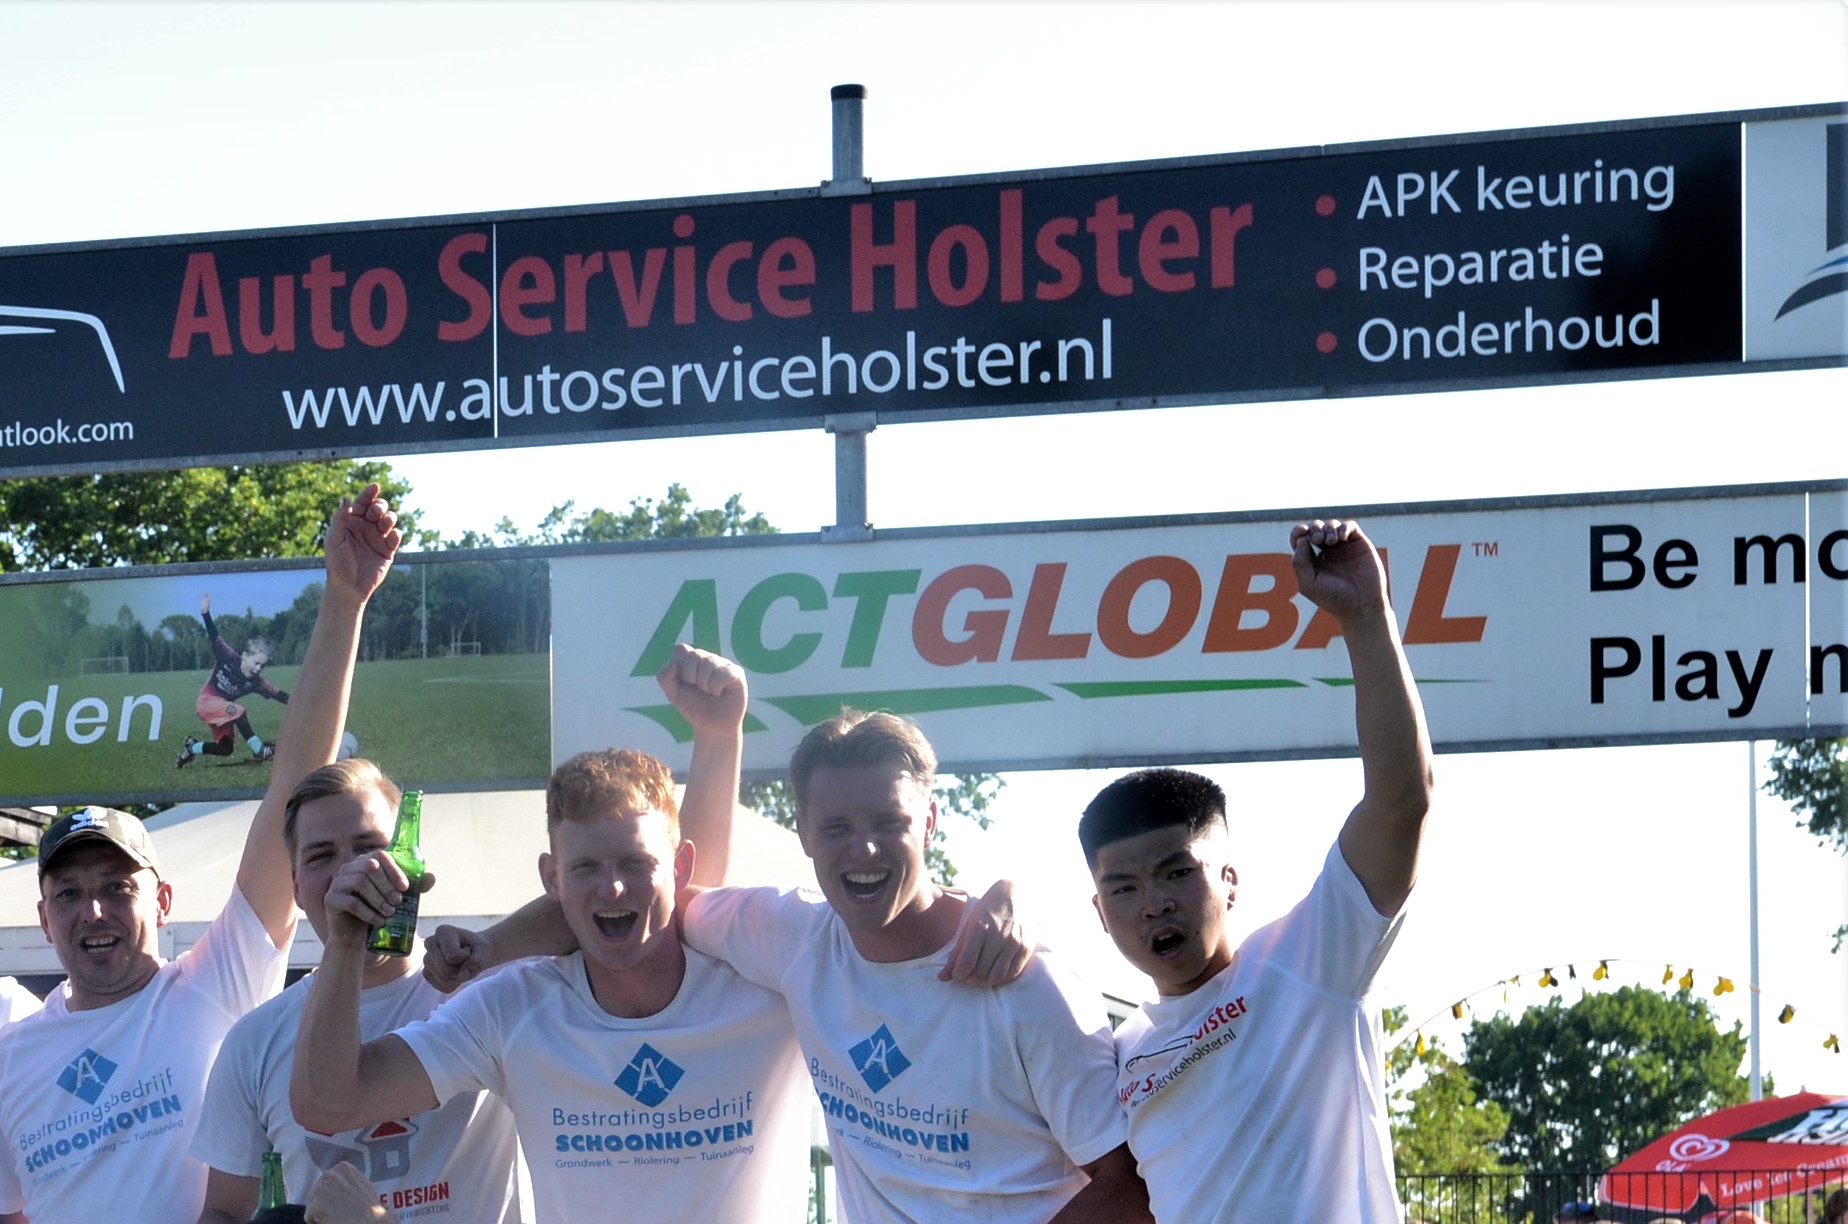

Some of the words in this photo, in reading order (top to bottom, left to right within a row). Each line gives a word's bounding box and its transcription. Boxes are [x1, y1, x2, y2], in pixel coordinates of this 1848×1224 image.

[1357, 167, 1463, 221] APK
[1477, 158, 1675, 212] keuring
[168, 251, 408, 359] Auto
[436, 214, 817, 342] Service
[850, 189, 1253, 313] Holster
[1359, 235, 1604, 298] Reparatie
[1357, 298, 1659, 364] Onderhoud
[282, 318, 1113, 430] www.autoserviceholster.nl
[1589, 524, 1699, 592] Be
[630, 544, 1488, 677] ACTGLOBL
[1590, 634, 1774, 719] Play
[19, 1067, 174, 1151] Bestratingsbedrijf
[553, 1091, 752, 1129] Bestratingsbedrijf
[811, 1057, 968, 1129] Bestratingsbedrijf
[815, 1087, 970, 1153] CHOONHOVEN
[555, 1120, 754, 1152] SCHOONHOVEN
[555, 1157, 612, 1168] Grondwerk
[393, 1181, 450, 1209] DESIGN
